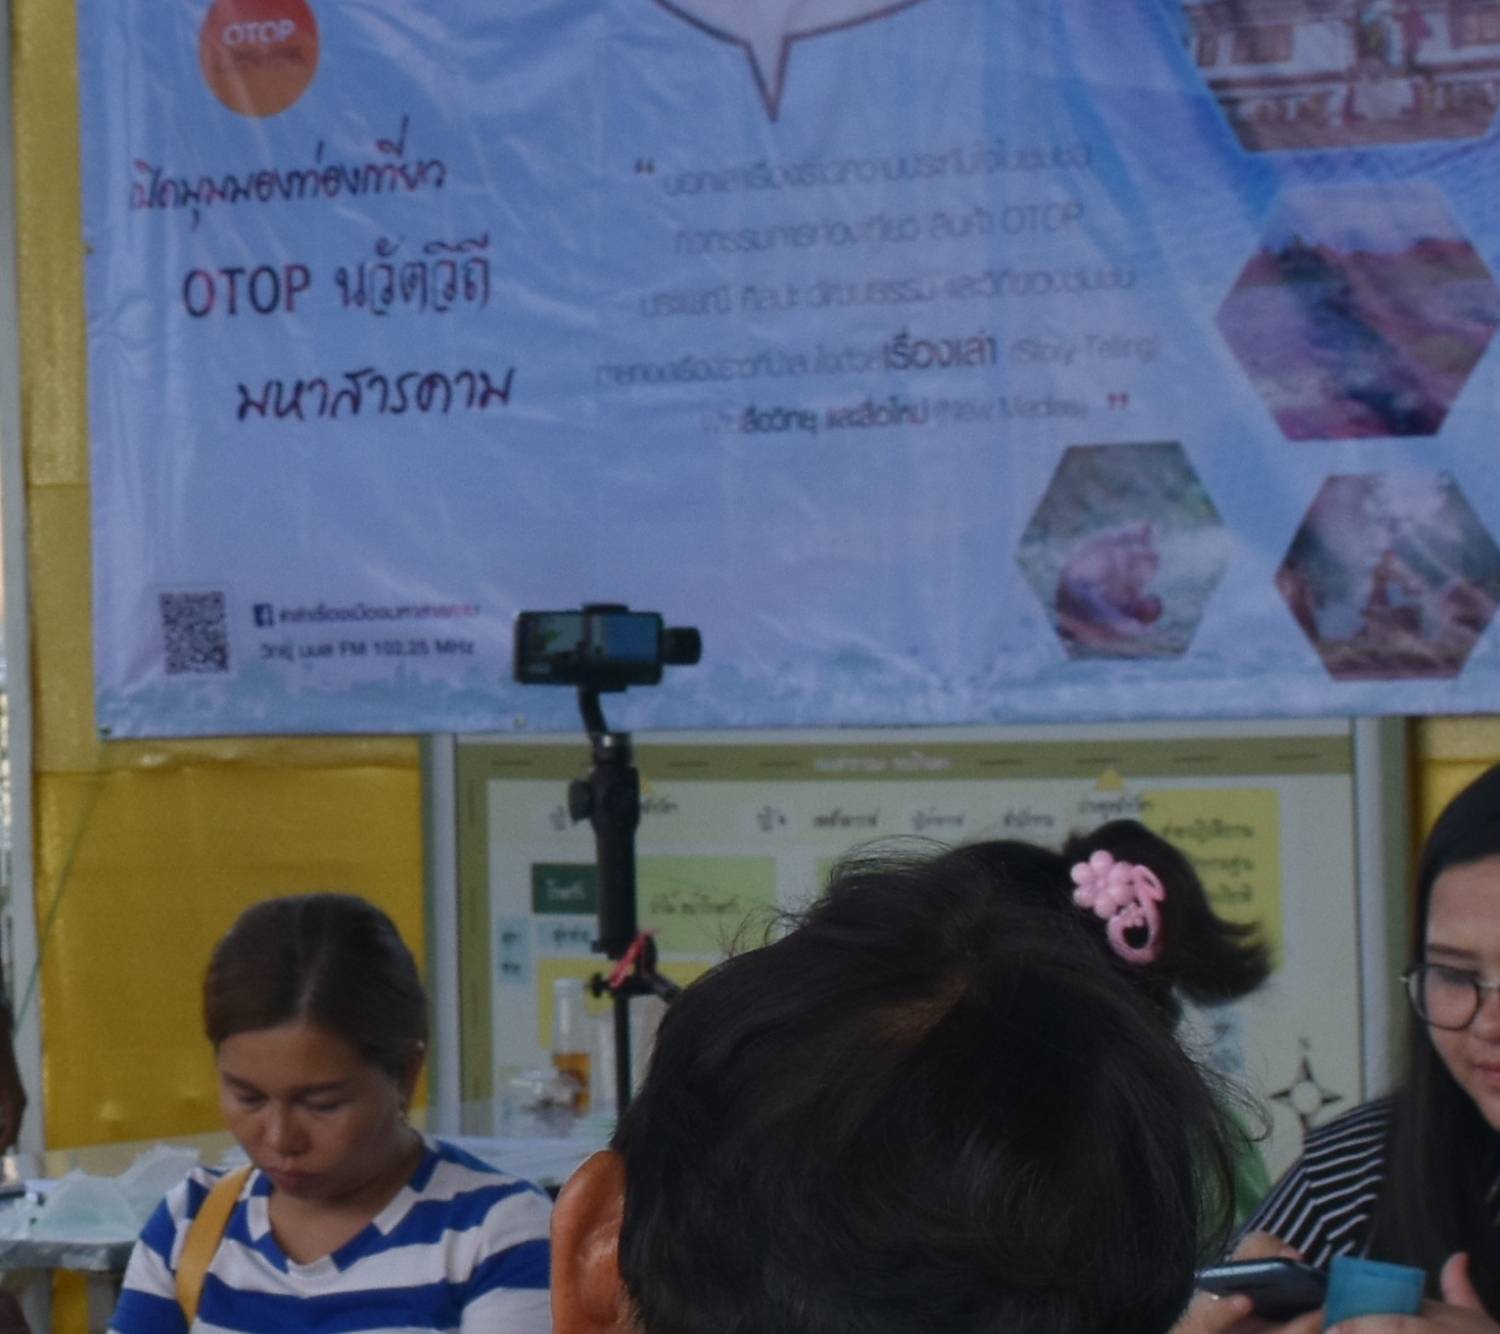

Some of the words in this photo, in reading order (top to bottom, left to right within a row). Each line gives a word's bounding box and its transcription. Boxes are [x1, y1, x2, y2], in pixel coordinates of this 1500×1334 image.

[222, 18, 297, 46] OTOP
[130, 113, 449, 230] เปิดมุมมองท่องเที่ยว
[1003, 202, 1085, 235] OTOP
[183, 265, 313, 318] OTOP
[334, 233, 491, 316] นวัตวิถี
[236, 365, 515, 423] มหาสารคาม
